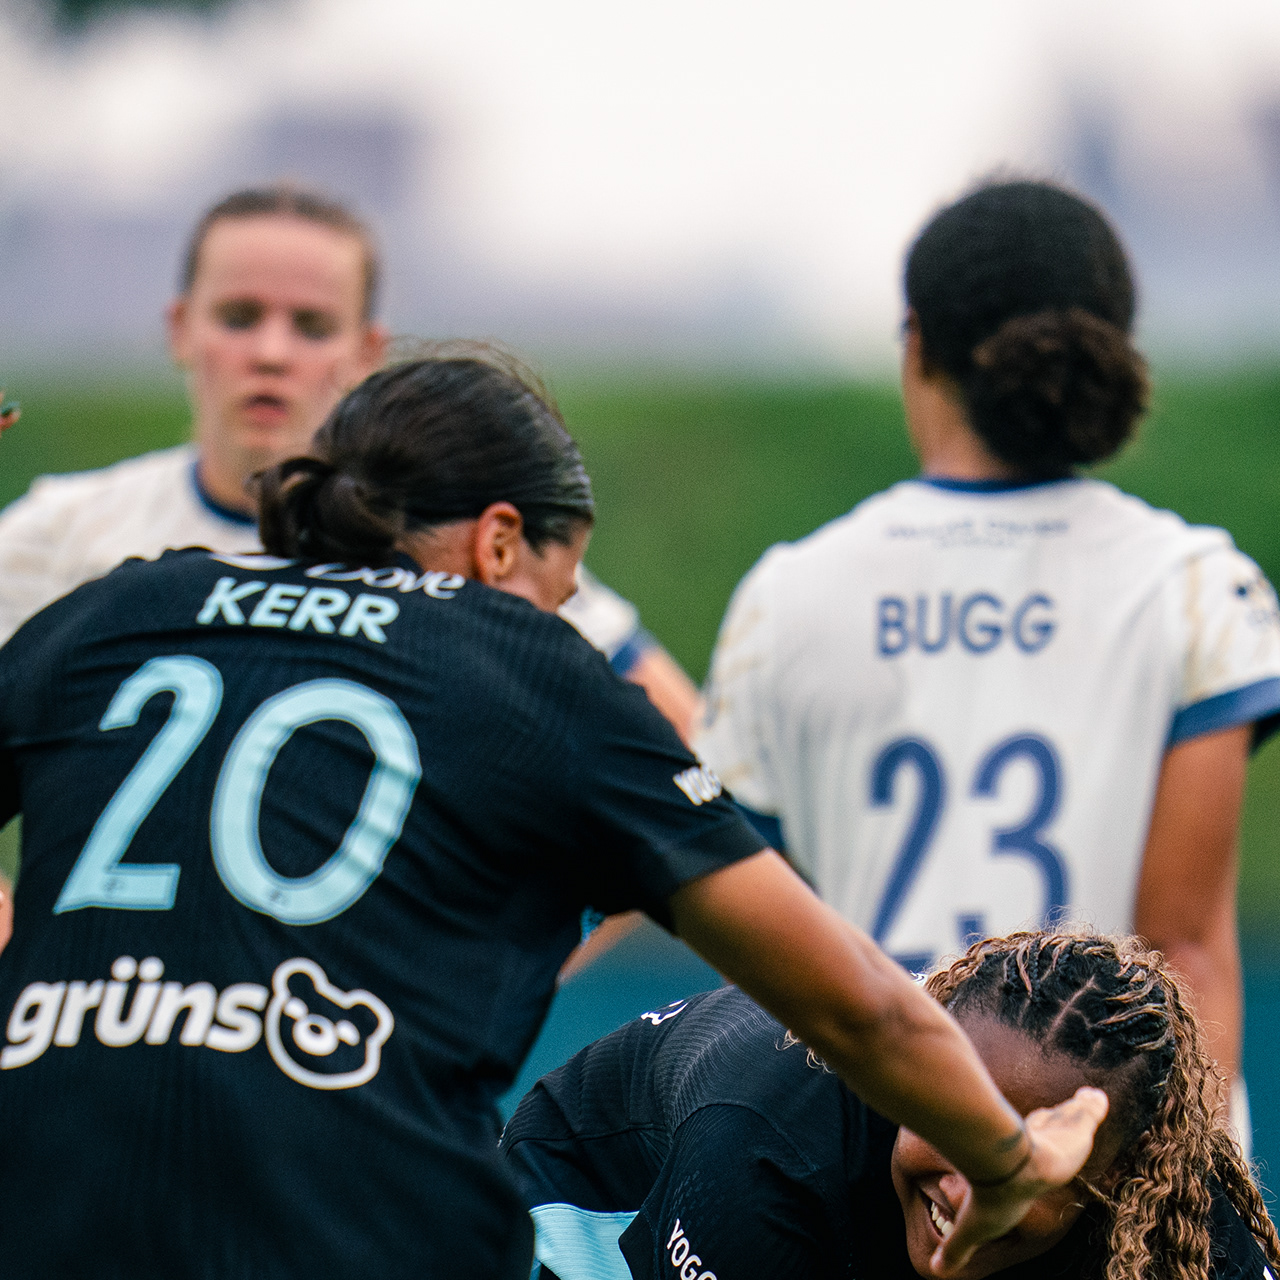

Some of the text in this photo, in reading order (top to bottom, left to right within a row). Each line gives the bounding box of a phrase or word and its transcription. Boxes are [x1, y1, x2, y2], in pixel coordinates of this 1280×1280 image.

[195, 575, 401, 645] KERR
[874, 588, 1059, 660] BUGG
[51, 654, 424, 927] 20
[867, 736, 1072, 968] 23
